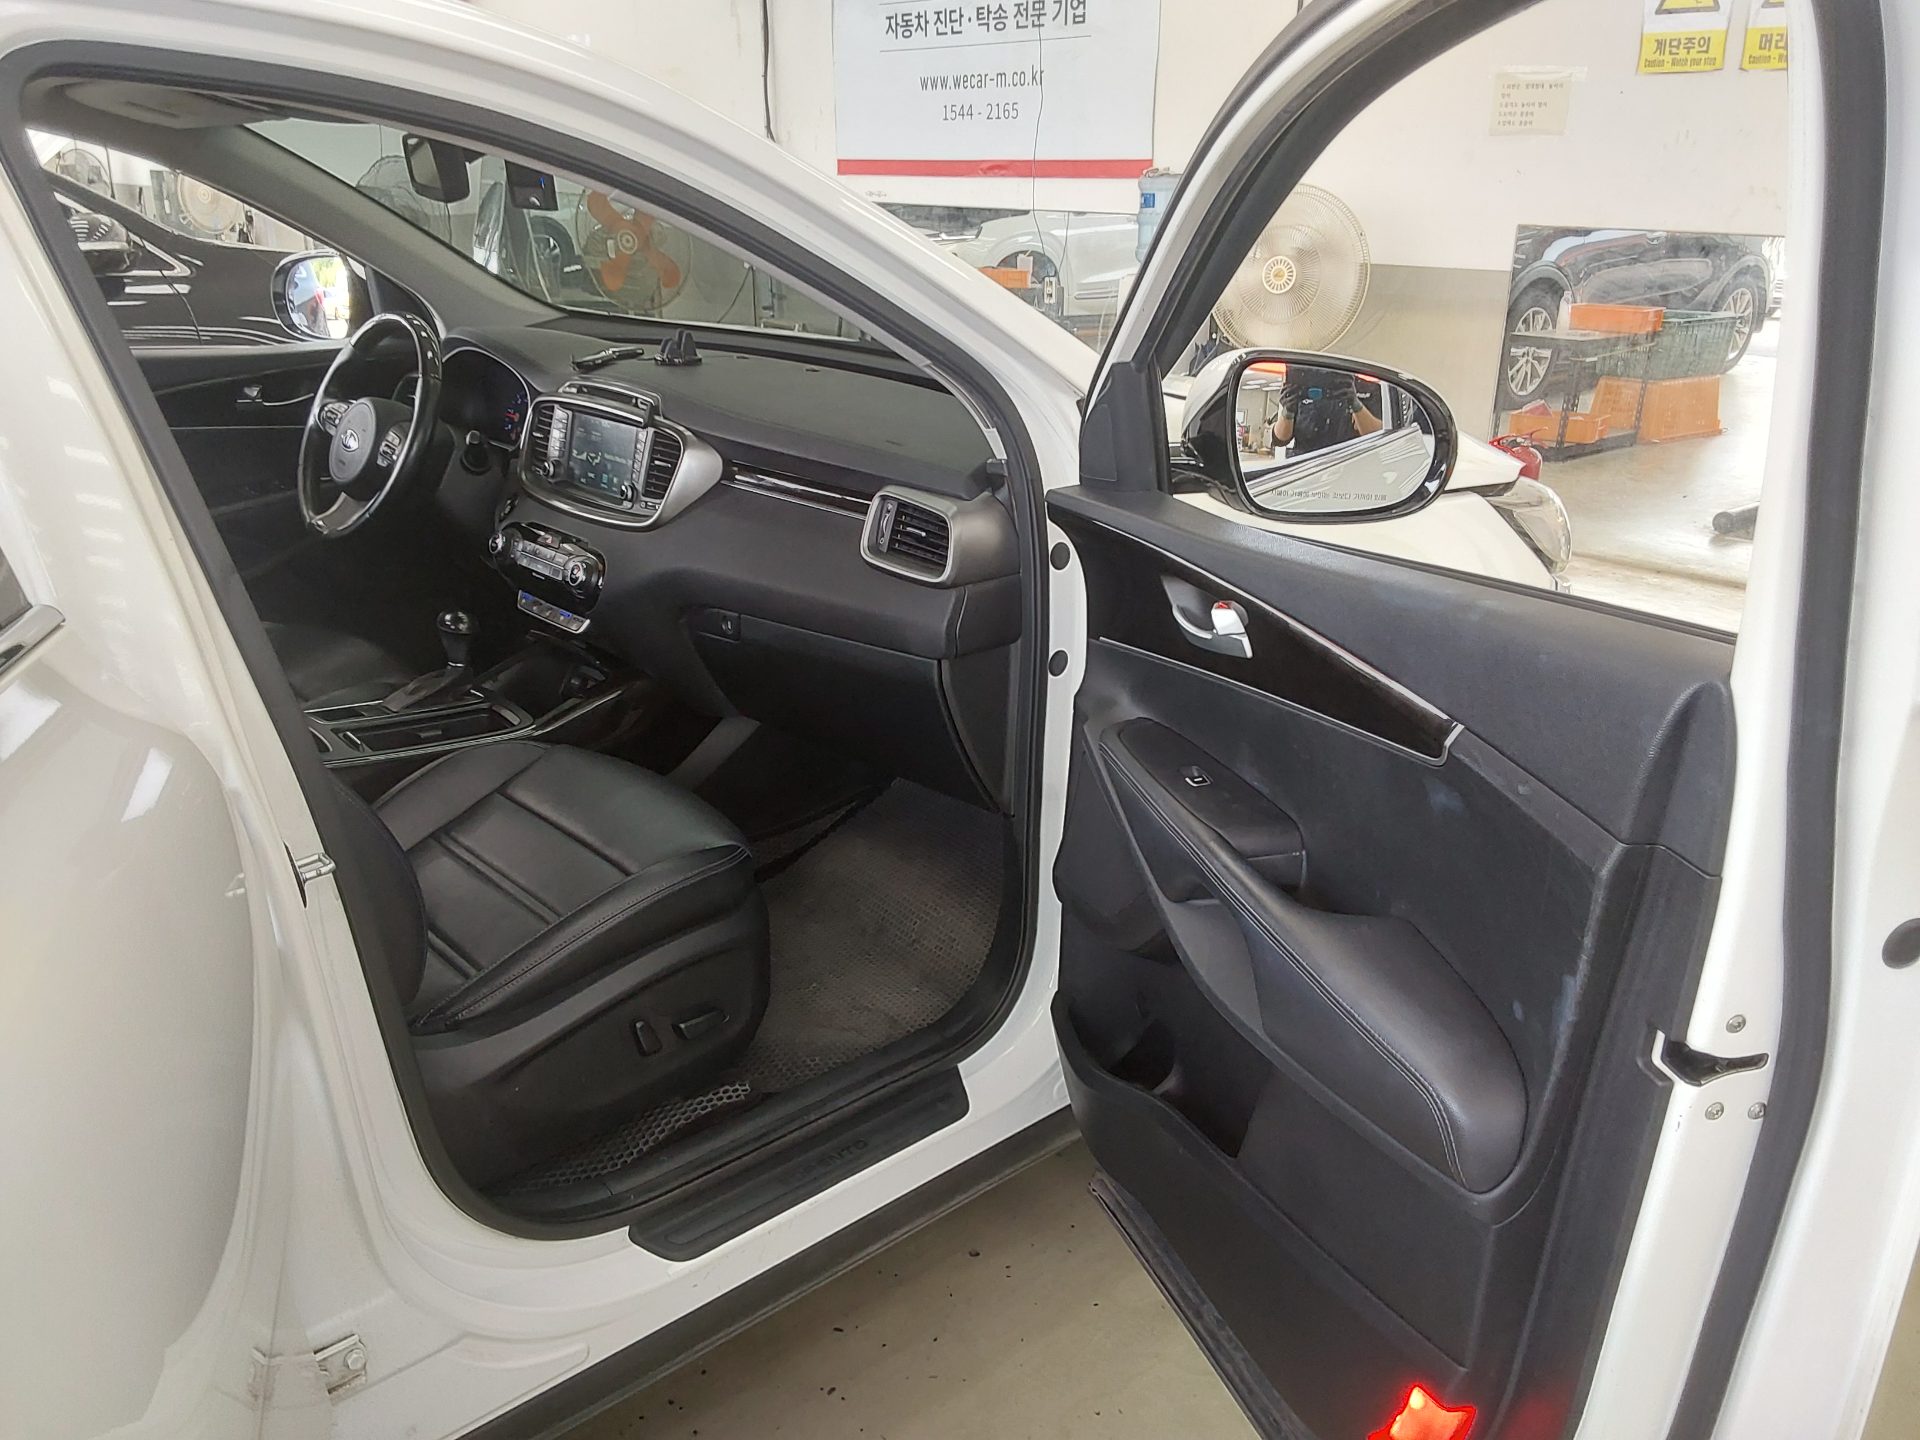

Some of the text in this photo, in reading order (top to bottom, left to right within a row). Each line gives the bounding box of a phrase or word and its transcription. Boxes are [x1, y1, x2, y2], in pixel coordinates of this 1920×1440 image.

[885, 9, 930, 40] 자동차
[1013, 0, 1047, 30] 전문
[1052, 0, 1087, 26] 기업
[1653, 36, 1711, 56] 계단주의
[1644, 58, 1665, 68] Caution
[1671, 57, 1689, 67] Watch
[1690, 58, 1702, 68] your
[1704, 57, 1717, 66] step
[1749, 54, 1771, 64] Caution
[920, 64, 1045, 91] www.wecar-m.co.kr
